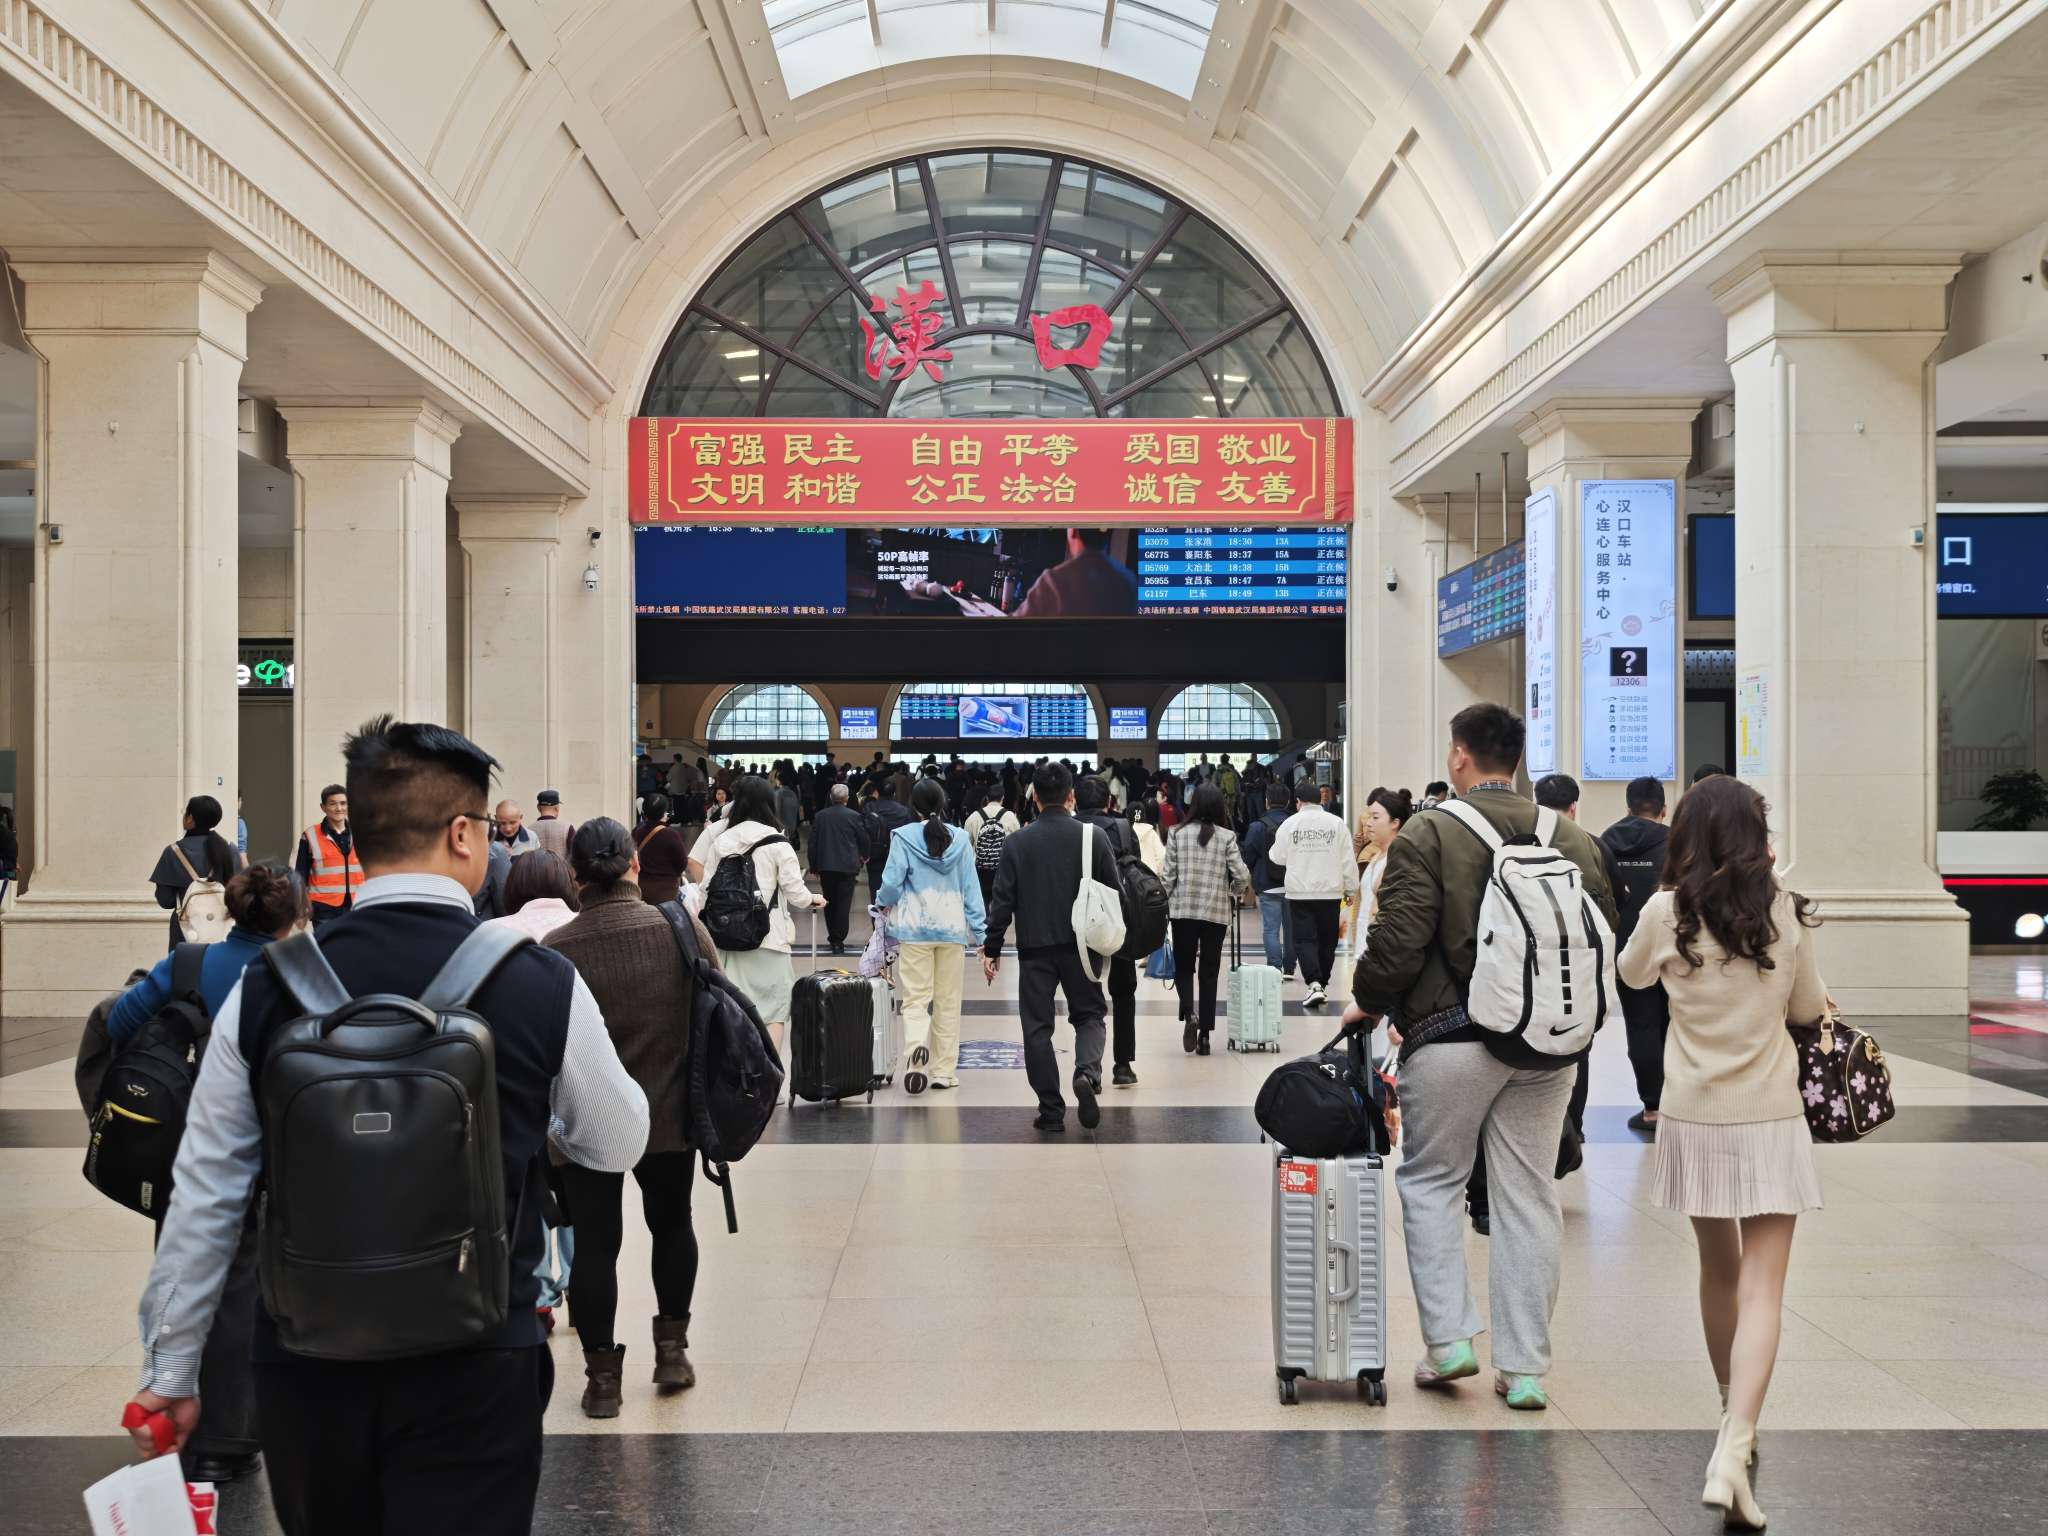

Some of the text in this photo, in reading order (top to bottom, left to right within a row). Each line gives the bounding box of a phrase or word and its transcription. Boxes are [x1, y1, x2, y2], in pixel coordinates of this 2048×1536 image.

[689, 432, 1297, 466] 富强 民主 自由 平等 爱国 敬业
[687, 471, 1297, 505] 文明 和谐 公正 法治 诚信 友善
[1144, 550, 1169, 559] G6775
[1229, 550, 1253, 559] 18:37
[1275, 550, 1290, 559] 15A
[1596, 500, 1610, 620] 心连心服务中心
[1144, 576, 1169, 585] D5955
[1184, 576, 1213, 585] 宜昌东
[1229, 576, 1253, 585] 18:47
[1276, 576, 1287, 585] 7A
[1144, 589, 1169, 598] G1157
[1189, 589, 1208, 598] 巴东
[1229, 589, 1253, 598] 18:49
[1275, 589, 1289, 598] 13B
[1616, 677, 1641, 686] 12306
